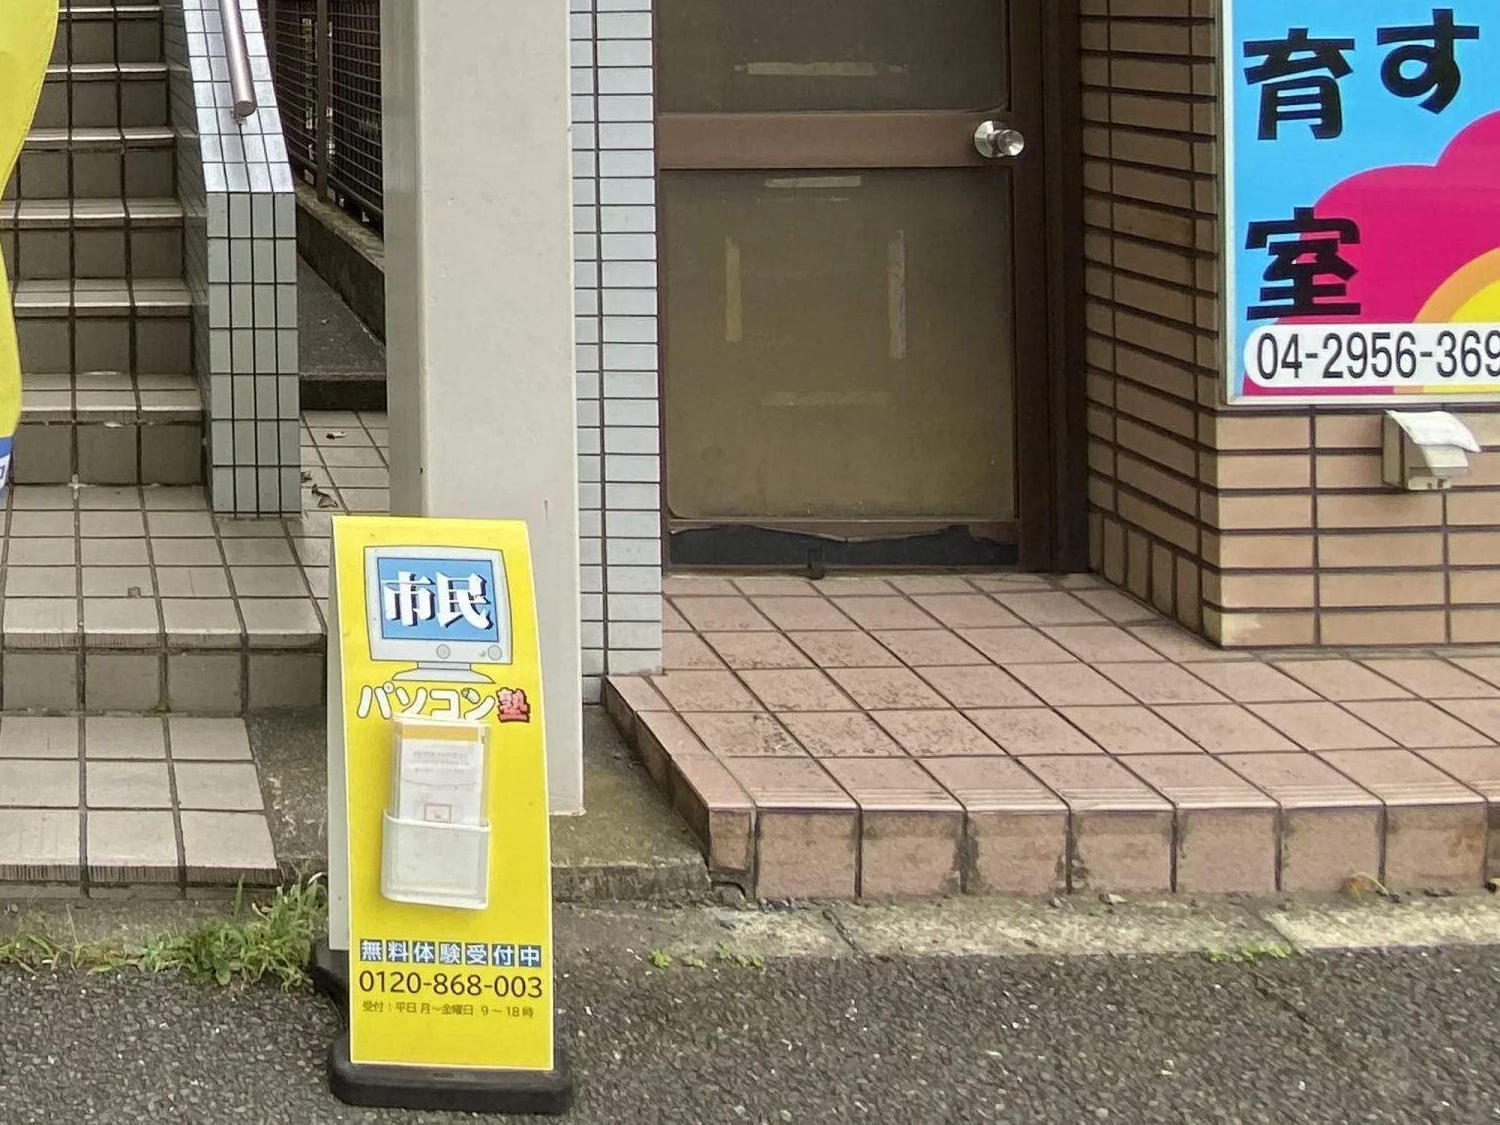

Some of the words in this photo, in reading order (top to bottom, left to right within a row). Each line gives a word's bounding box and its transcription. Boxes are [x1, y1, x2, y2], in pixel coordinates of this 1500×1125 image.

[380, 571, 494, 630] 市民
[357, 681, 531, 723] パソコン塾
[360, 940, 541, 967] 無料体験受付中
[359, 970, 543, 998] 0120-868-003
